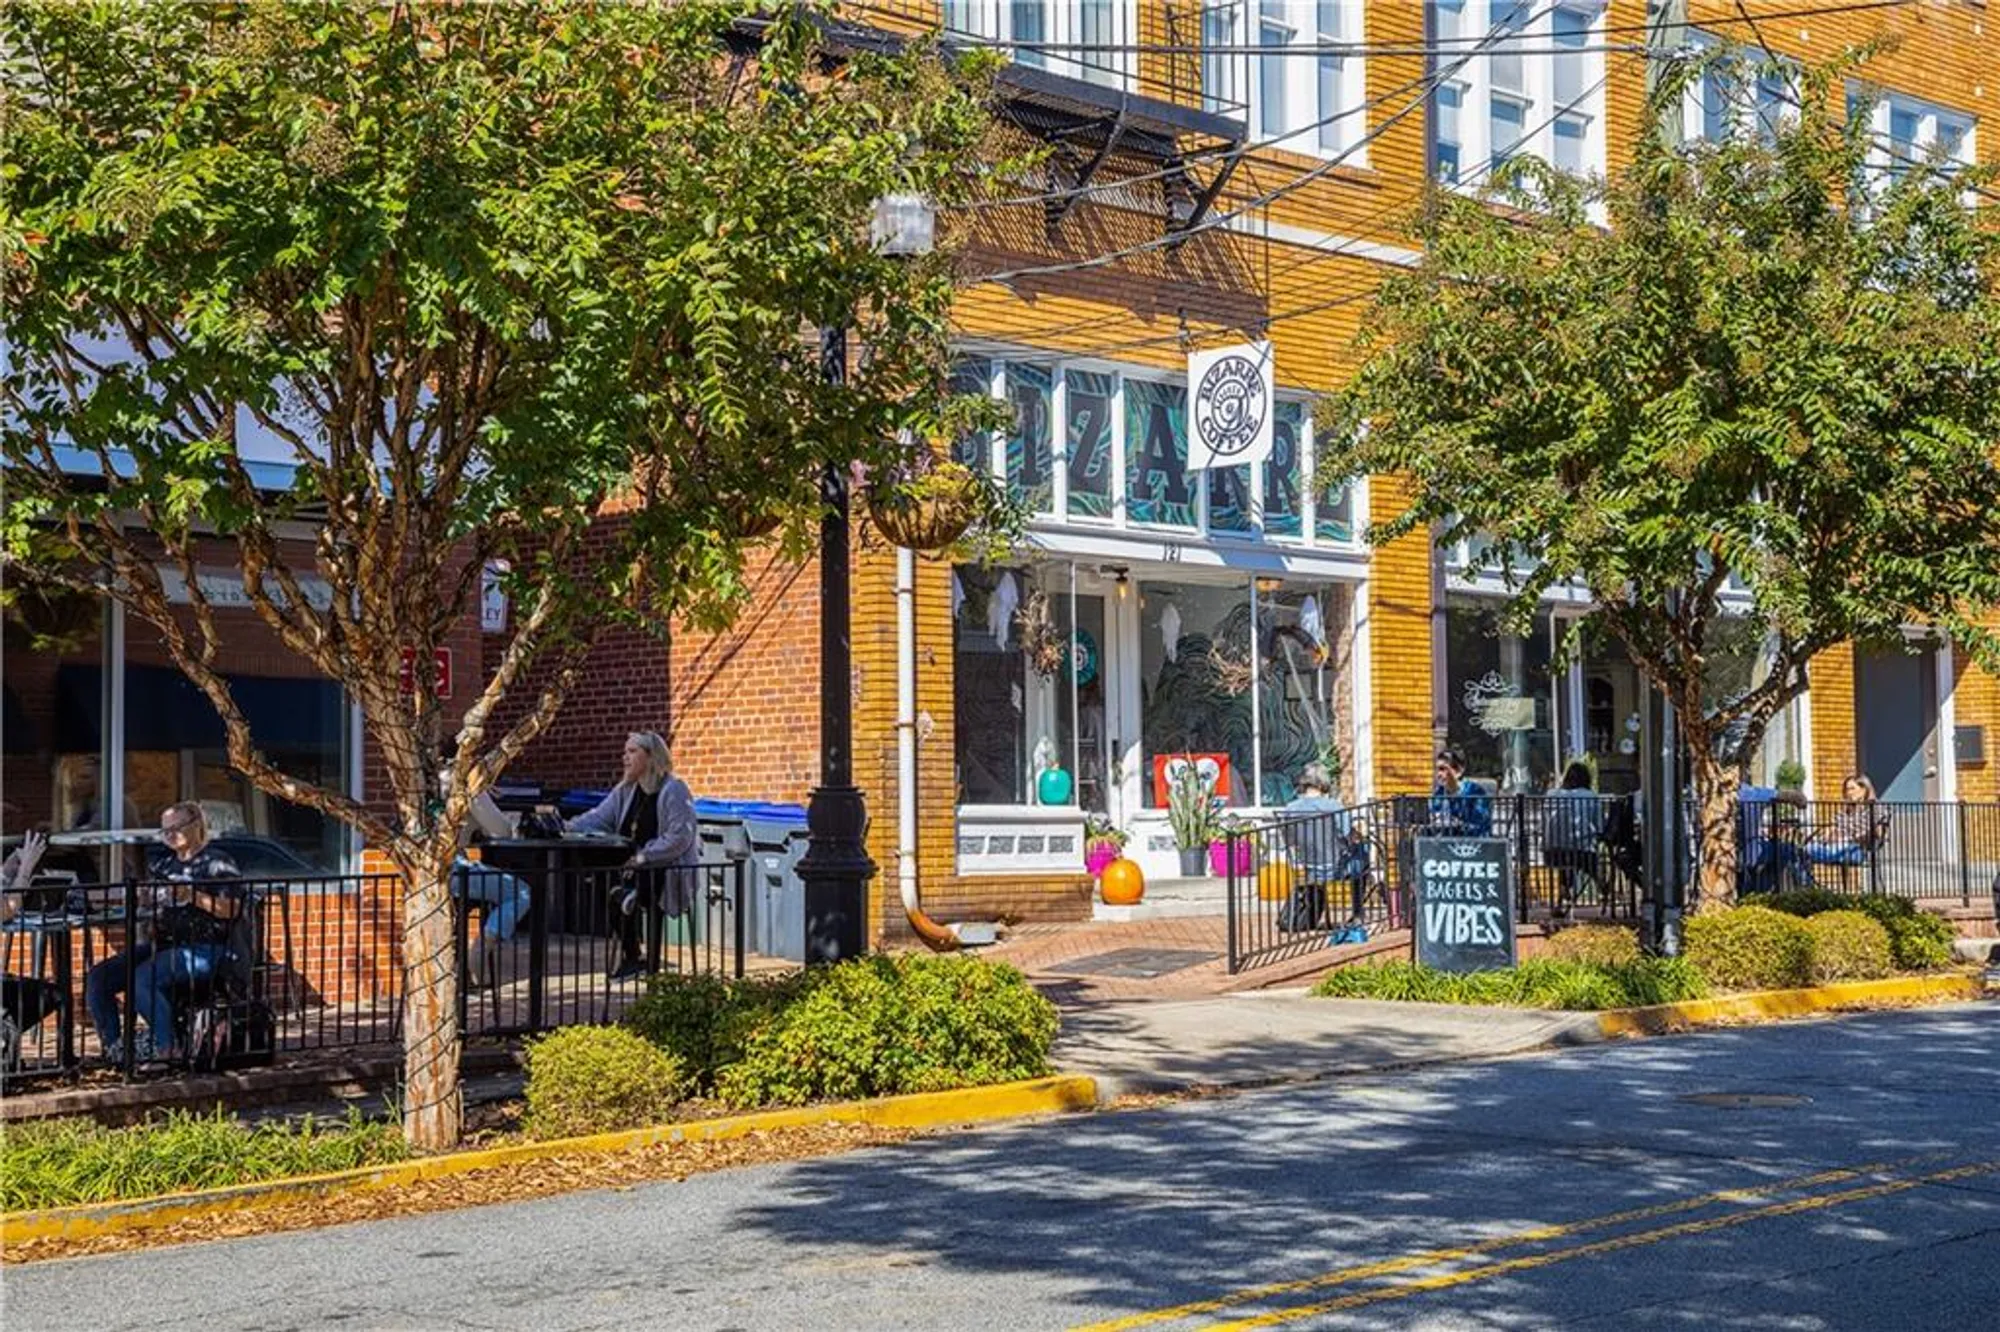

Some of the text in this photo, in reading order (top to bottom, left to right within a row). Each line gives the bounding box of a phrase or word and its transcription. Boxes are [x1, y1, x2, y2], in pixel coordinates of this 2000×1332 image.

[1201, 360, 1261, 402] BIZARRE
[1202, 415, 1259, 450] COFFEE
[1162, 542, 1181, 563] 121
[1423, 859, 1499, 878] COFFEE
[1427, 880, 1499, 901] BAGELS &
[1424, 902, 1504, 944] VIBES
